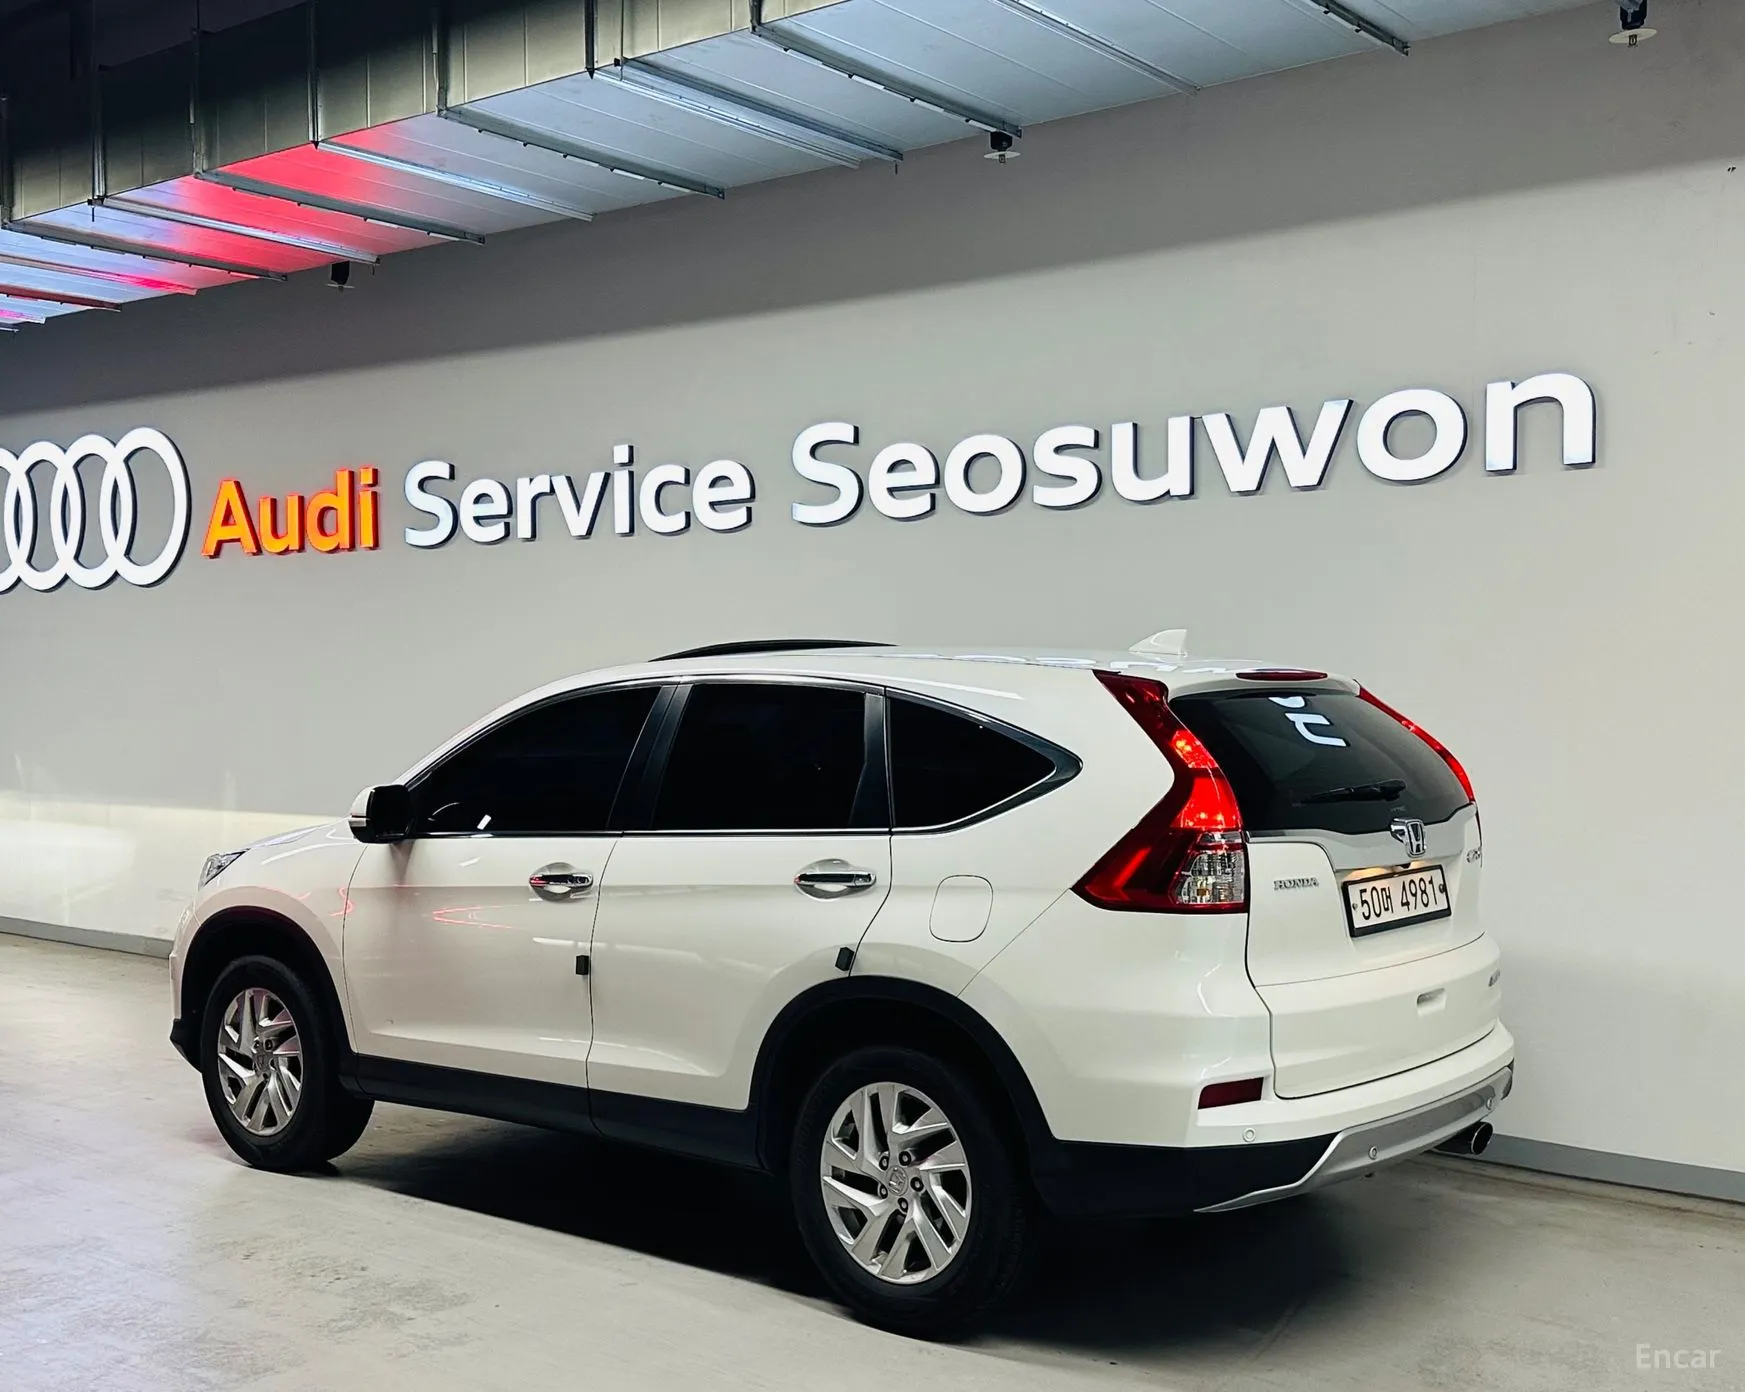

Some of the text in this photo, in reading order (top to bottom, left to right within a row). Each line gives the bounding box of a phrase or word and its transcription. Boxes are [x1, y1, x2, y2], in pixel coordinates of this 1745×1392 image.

[202, 372, 1597, 558] Audi Service Seosuwon
[1273, 877, 1320, 891] HONDA
[1359, 875, 1438, 920] 50머 4981
